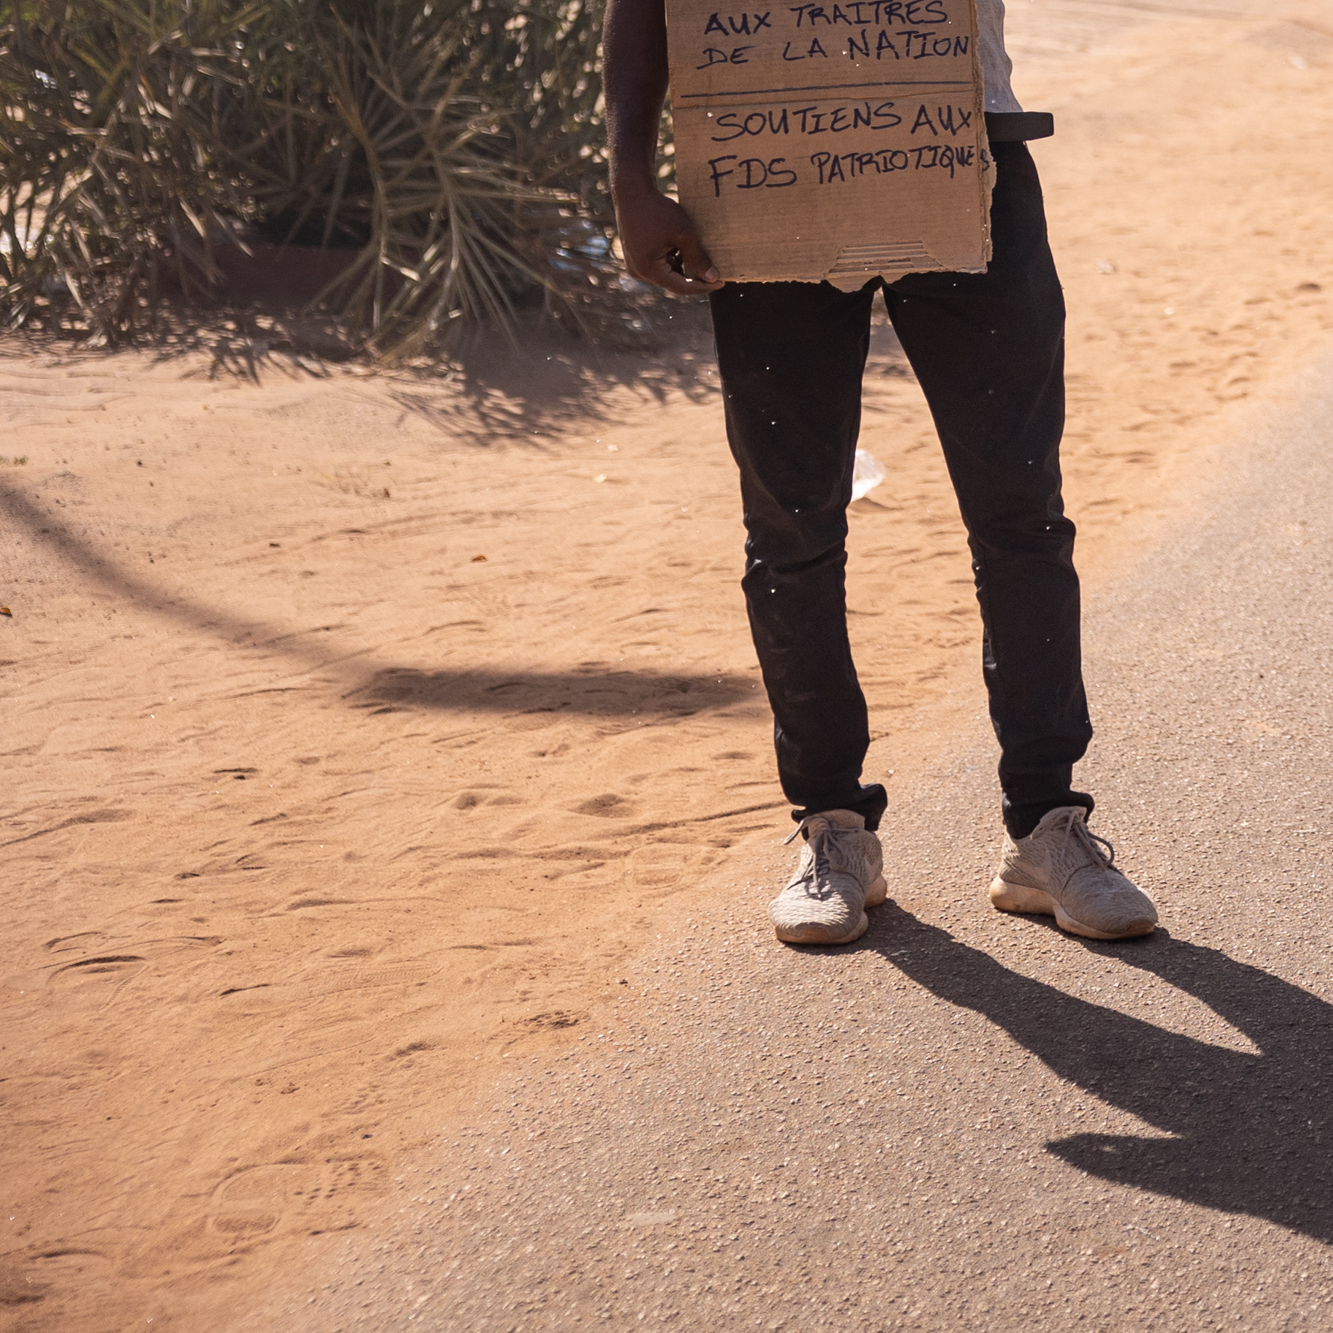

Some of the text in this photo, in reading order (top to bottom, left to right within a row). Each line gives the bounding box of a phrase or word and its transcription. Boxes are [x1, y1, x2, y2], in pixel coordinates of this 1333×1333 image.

[704, 0, 948, 36] AUX TRAITRES
[695, 28, 970, 70] DE LA NATION
[711, 101, 973, 142] SOUTIENS AUX
[708, 144, 991, 197] FDS PATRIOTIQUES
